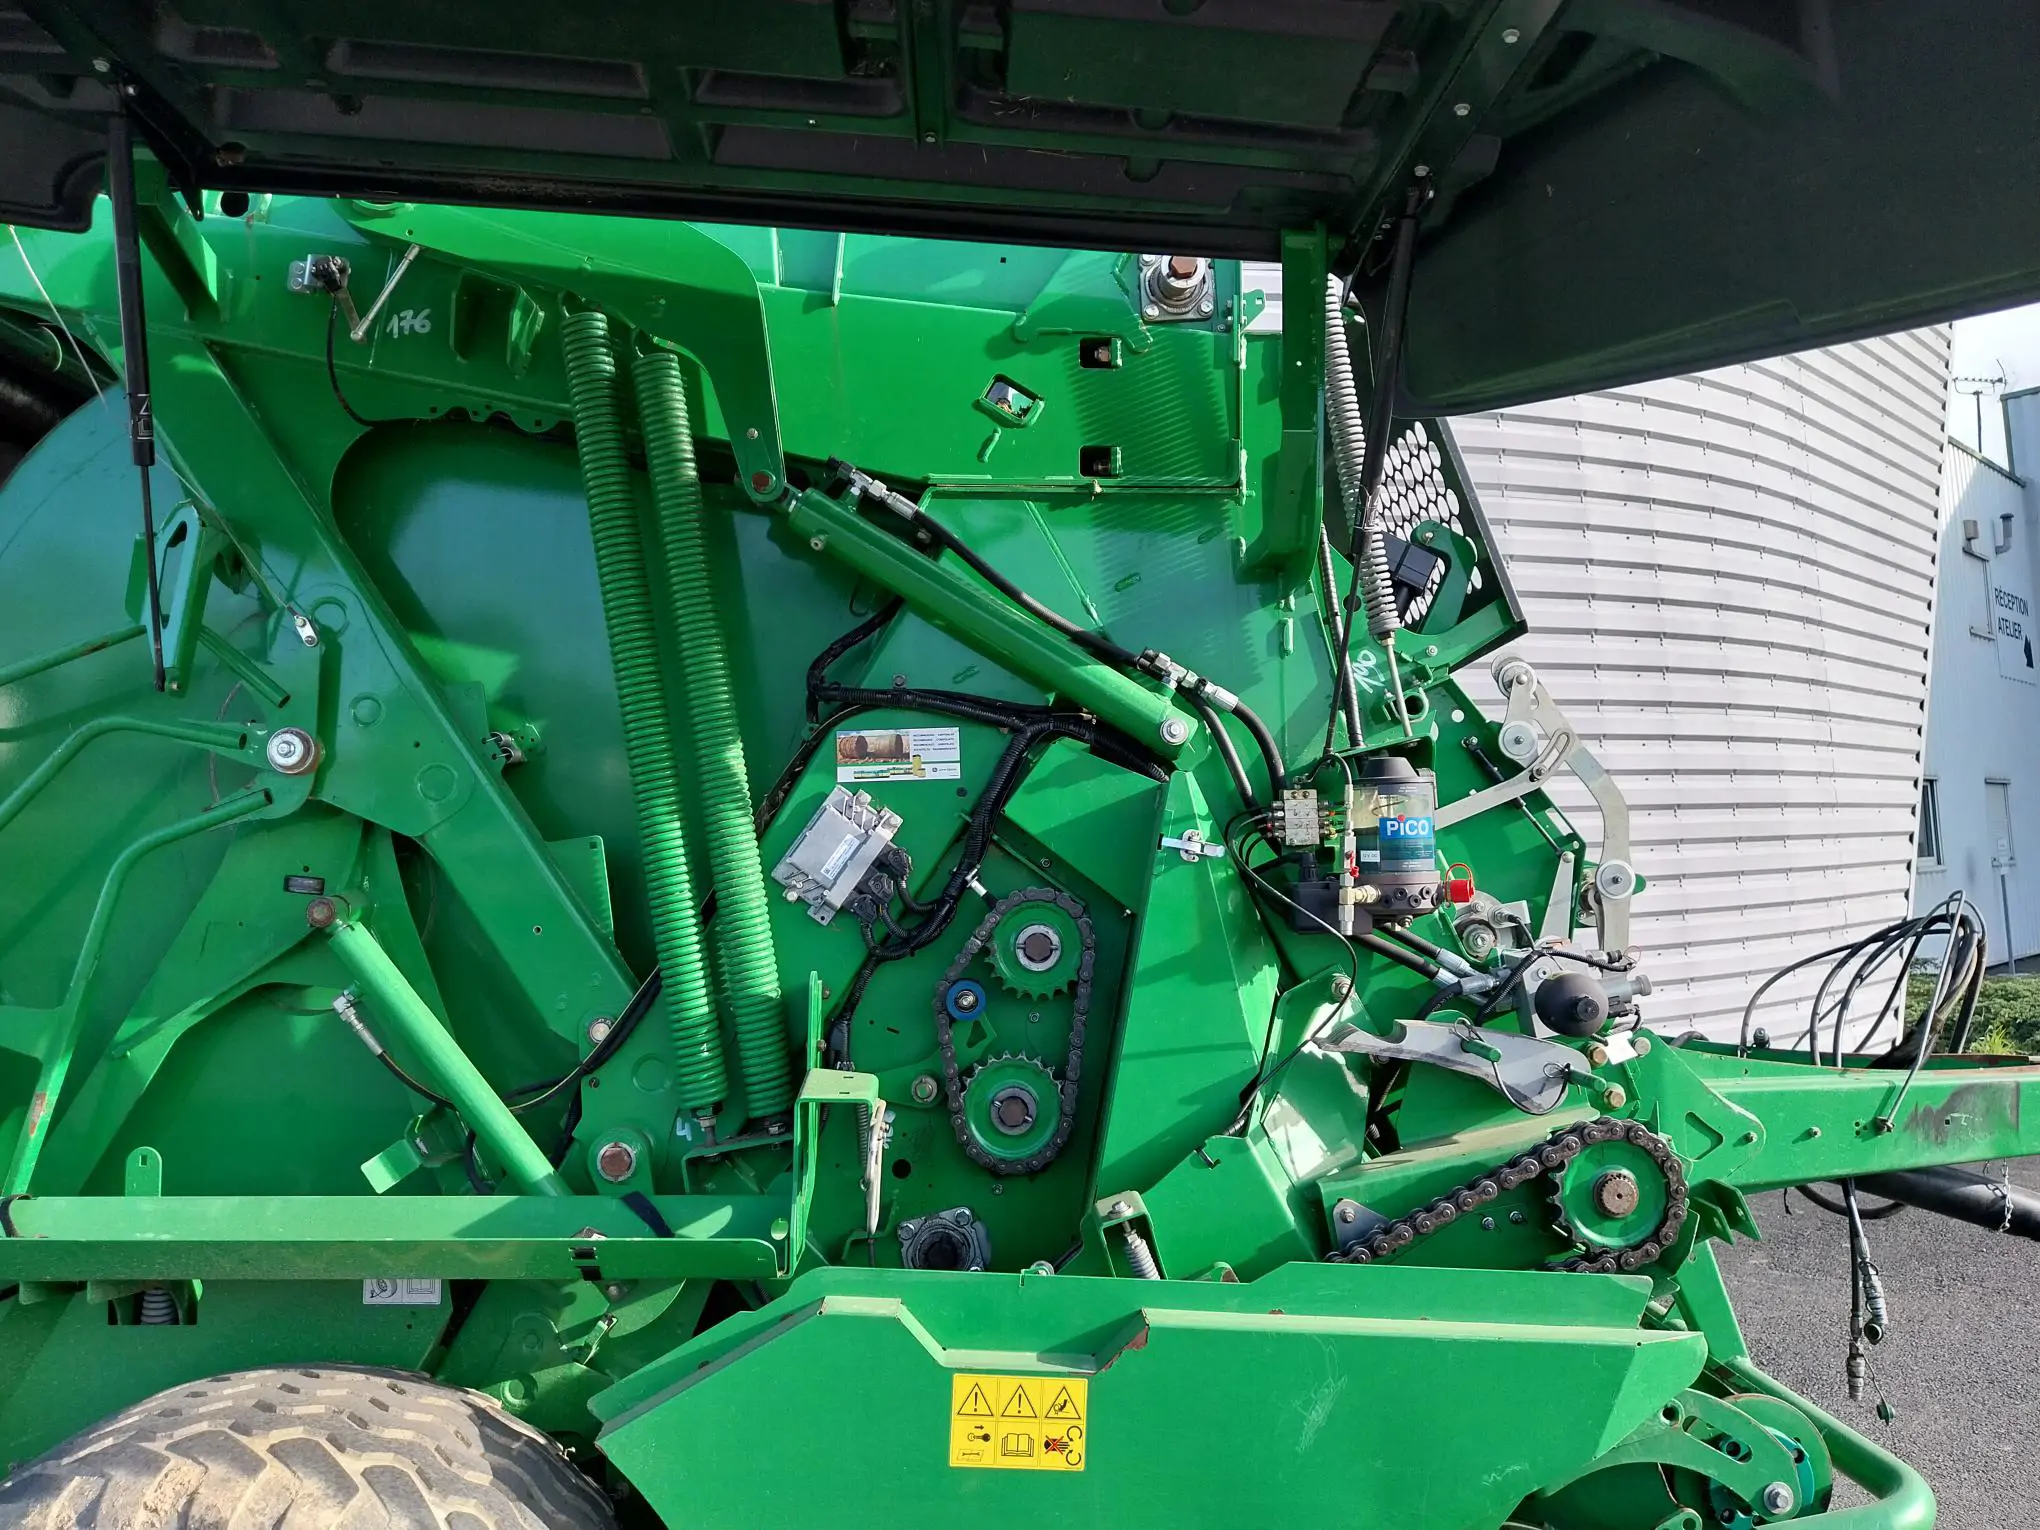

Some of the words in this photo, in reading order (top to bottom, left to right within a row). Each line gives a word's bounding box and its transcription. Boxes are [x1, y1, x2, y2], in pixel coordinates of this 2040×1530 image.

[386, 308, 431, 339] 176
[1994, 586, 2029, 616] RÉCEPTION
[1998, 617, 2023, 640] ATELIER
